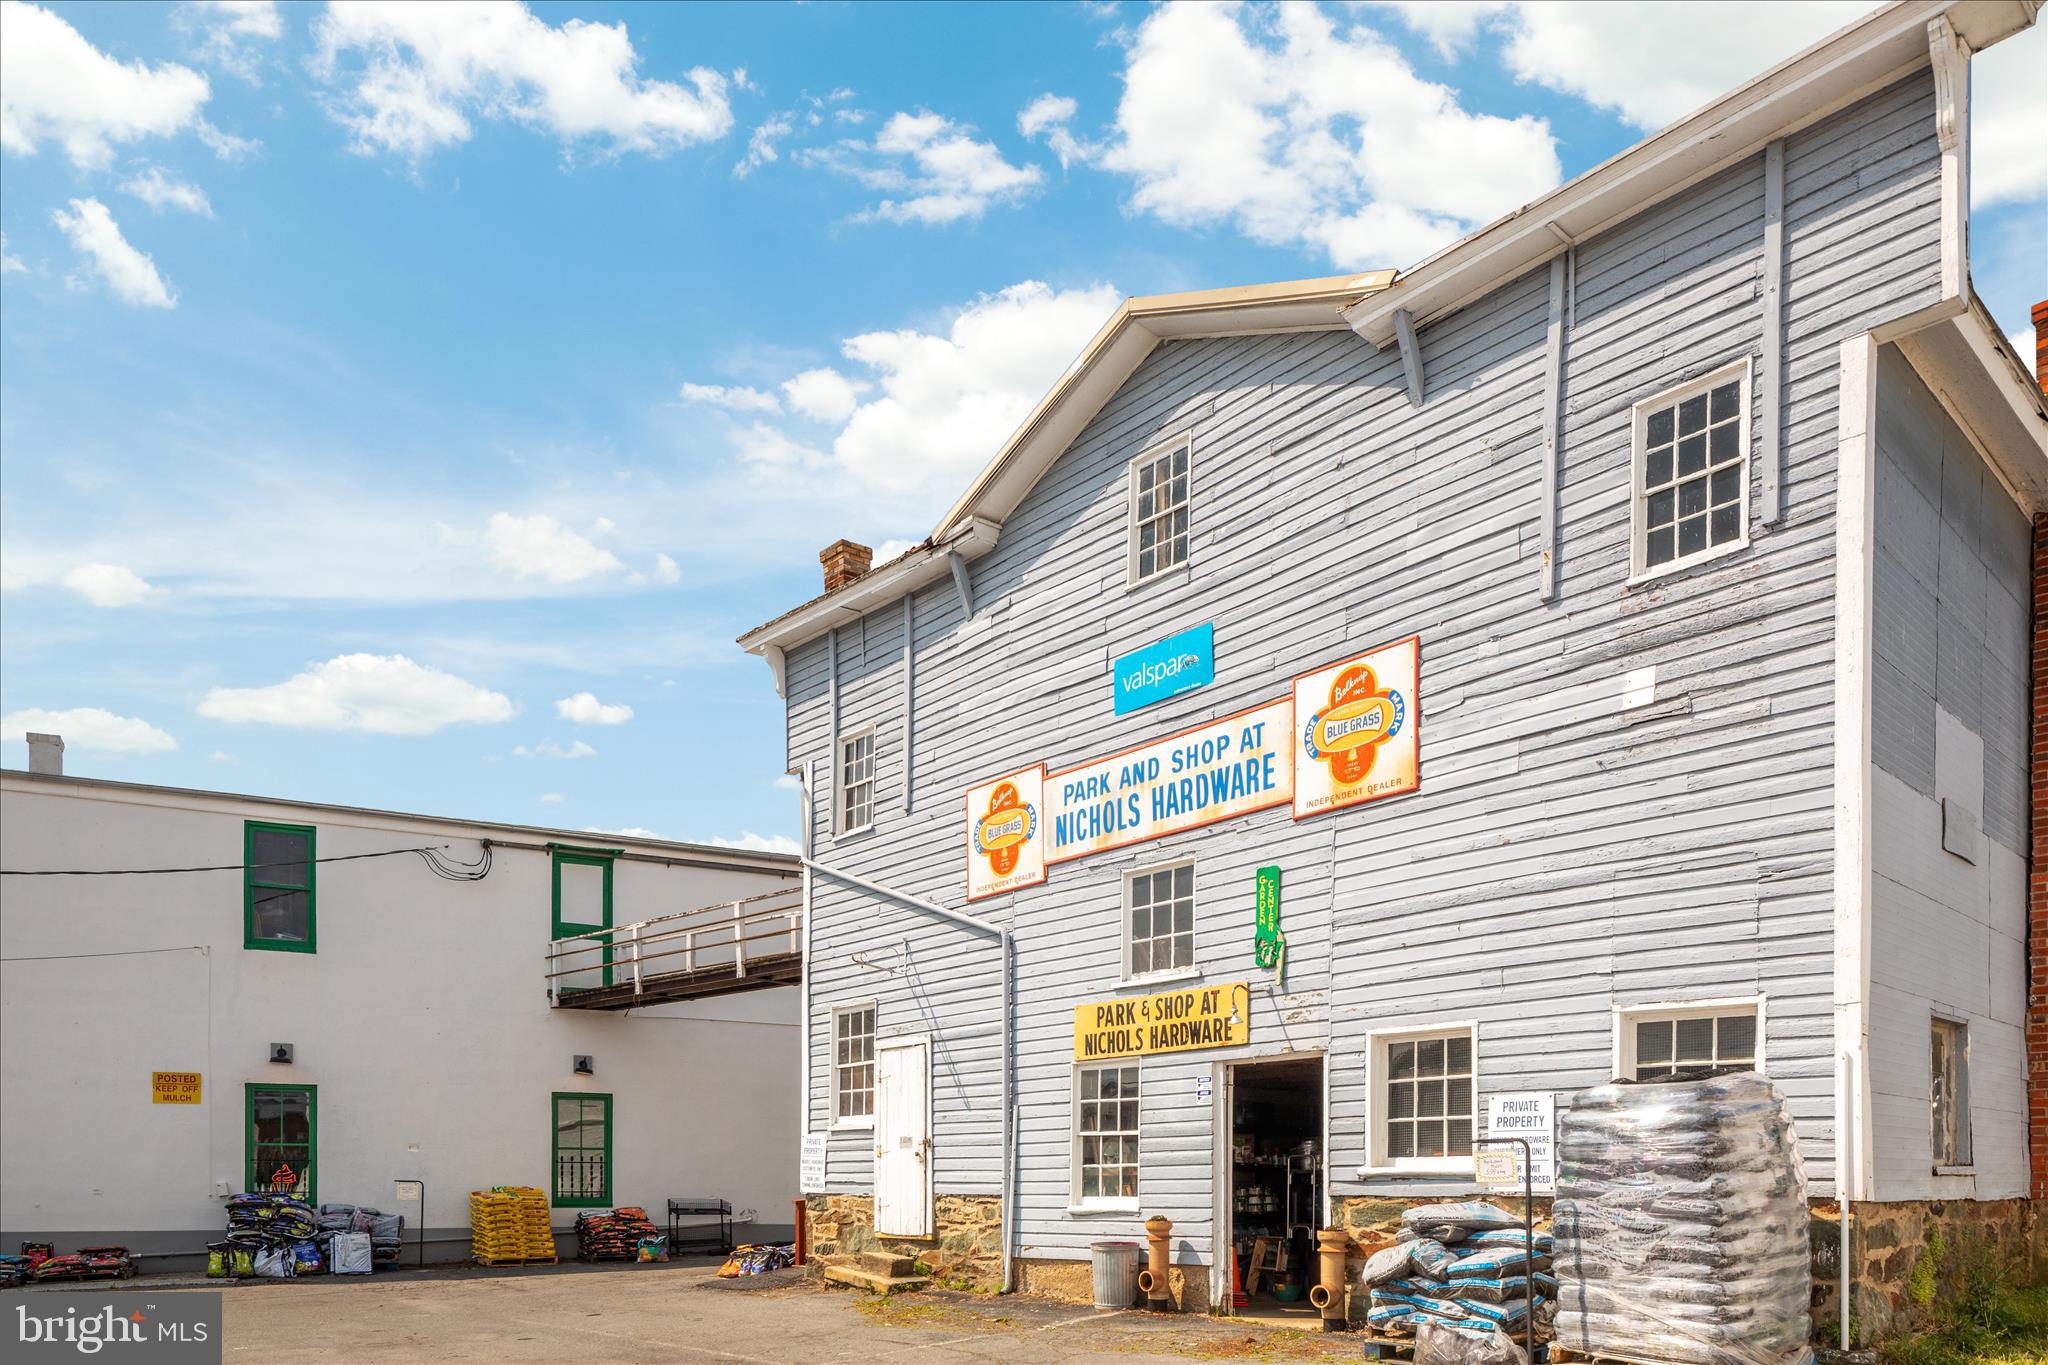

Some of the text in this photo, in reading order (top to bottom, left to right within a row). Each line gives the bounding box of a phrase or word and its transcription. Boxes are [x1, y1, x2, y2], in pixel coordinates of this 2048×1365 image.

[1123, 653, 1188, 692] valspar
[1334, 671, 1369, 703] Belknap
[1327, 711, 1380, 739] BLUE GRASS
[1390, 693, 1404, 735] MARK
[1305, 716, 1318, 757] TRADE
[1063, 721, 1266, 806] PARK AND SHOP AT
[1055, 752, 1276, 847] NICHOLS HARDWARE
[1306, 777, 1402, 809] INDEPENDENT DEALER
[987, 819, 1022, 839] BLUE GRASS
[976, 871, 1036, 893] INDEPENDENT DEALER
[1267, 879, 1275, 932] CENTER
[1096, 989, 1220, 1028] PARK & SHOP AT
[1085, 1016, 1233, 1056] NICHOLS HARDWARE
[155, 1085, 198, 1093] KEEP OFF
[157, 1074, 196, 1083] POSTED
[162, 1094, 192, 1102] MULCH
[1502, 1100, 1540, 1113] PRIVATE
[1496, 1115, 1545, 1128] PROPERTY
[1531, 1147, 1547, 1156] ONLY
[1518, 1175, 1550, 1184] ENORCED
